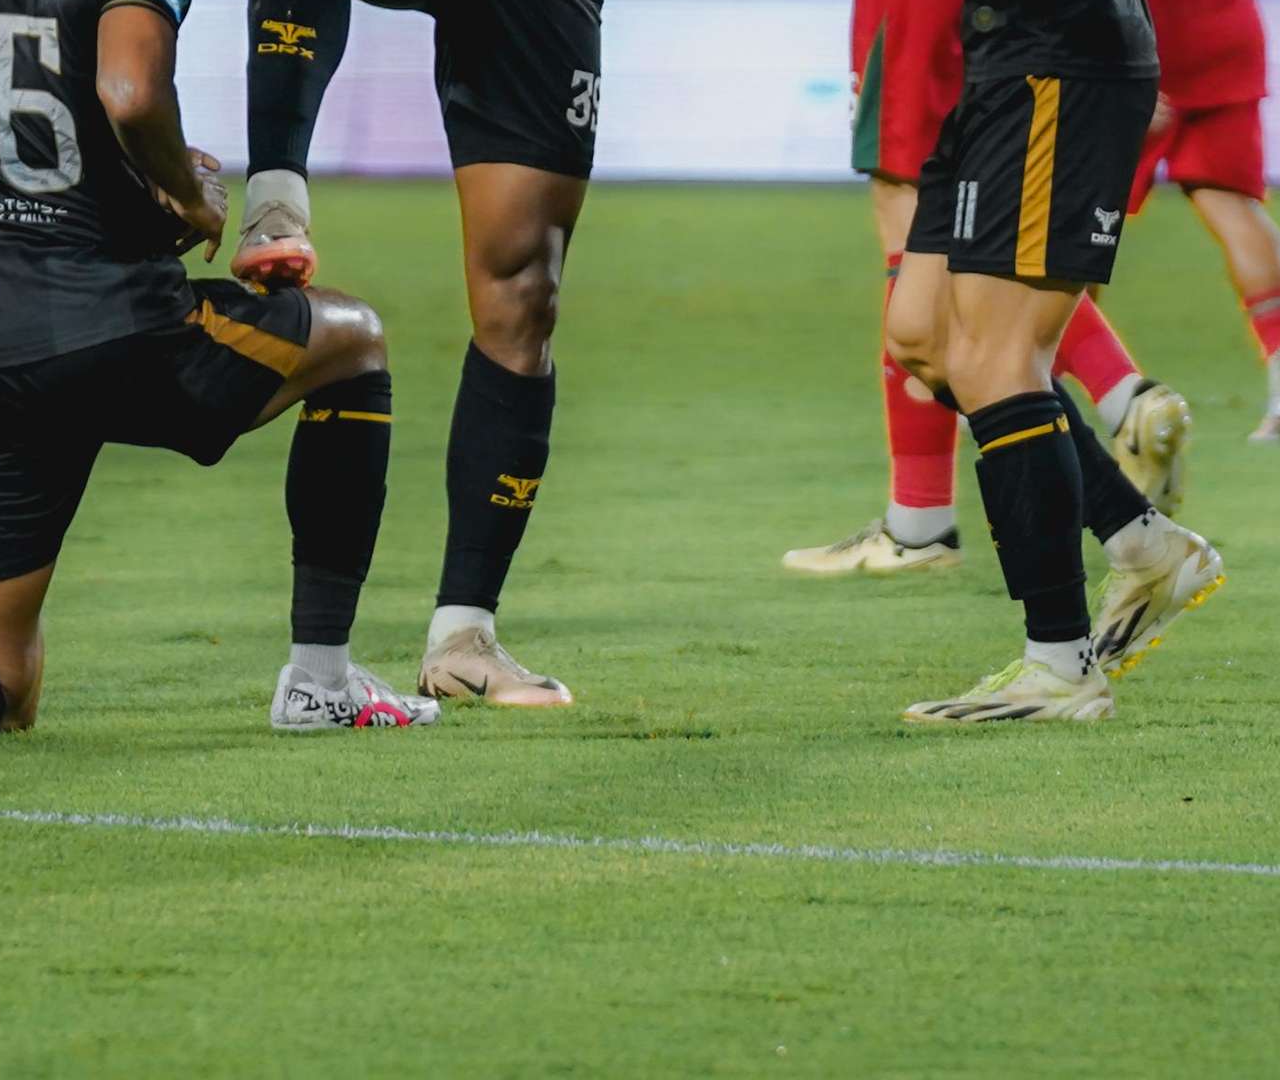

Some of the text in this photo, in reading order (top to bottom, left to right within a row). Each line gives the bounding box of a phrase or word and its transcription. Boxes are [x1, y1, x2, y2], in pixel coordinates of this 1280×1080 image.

[257, 43, 315, 61] DRX
[953, 180, 979, 239] 11
[1090, 232, 1117, 245] DRX
